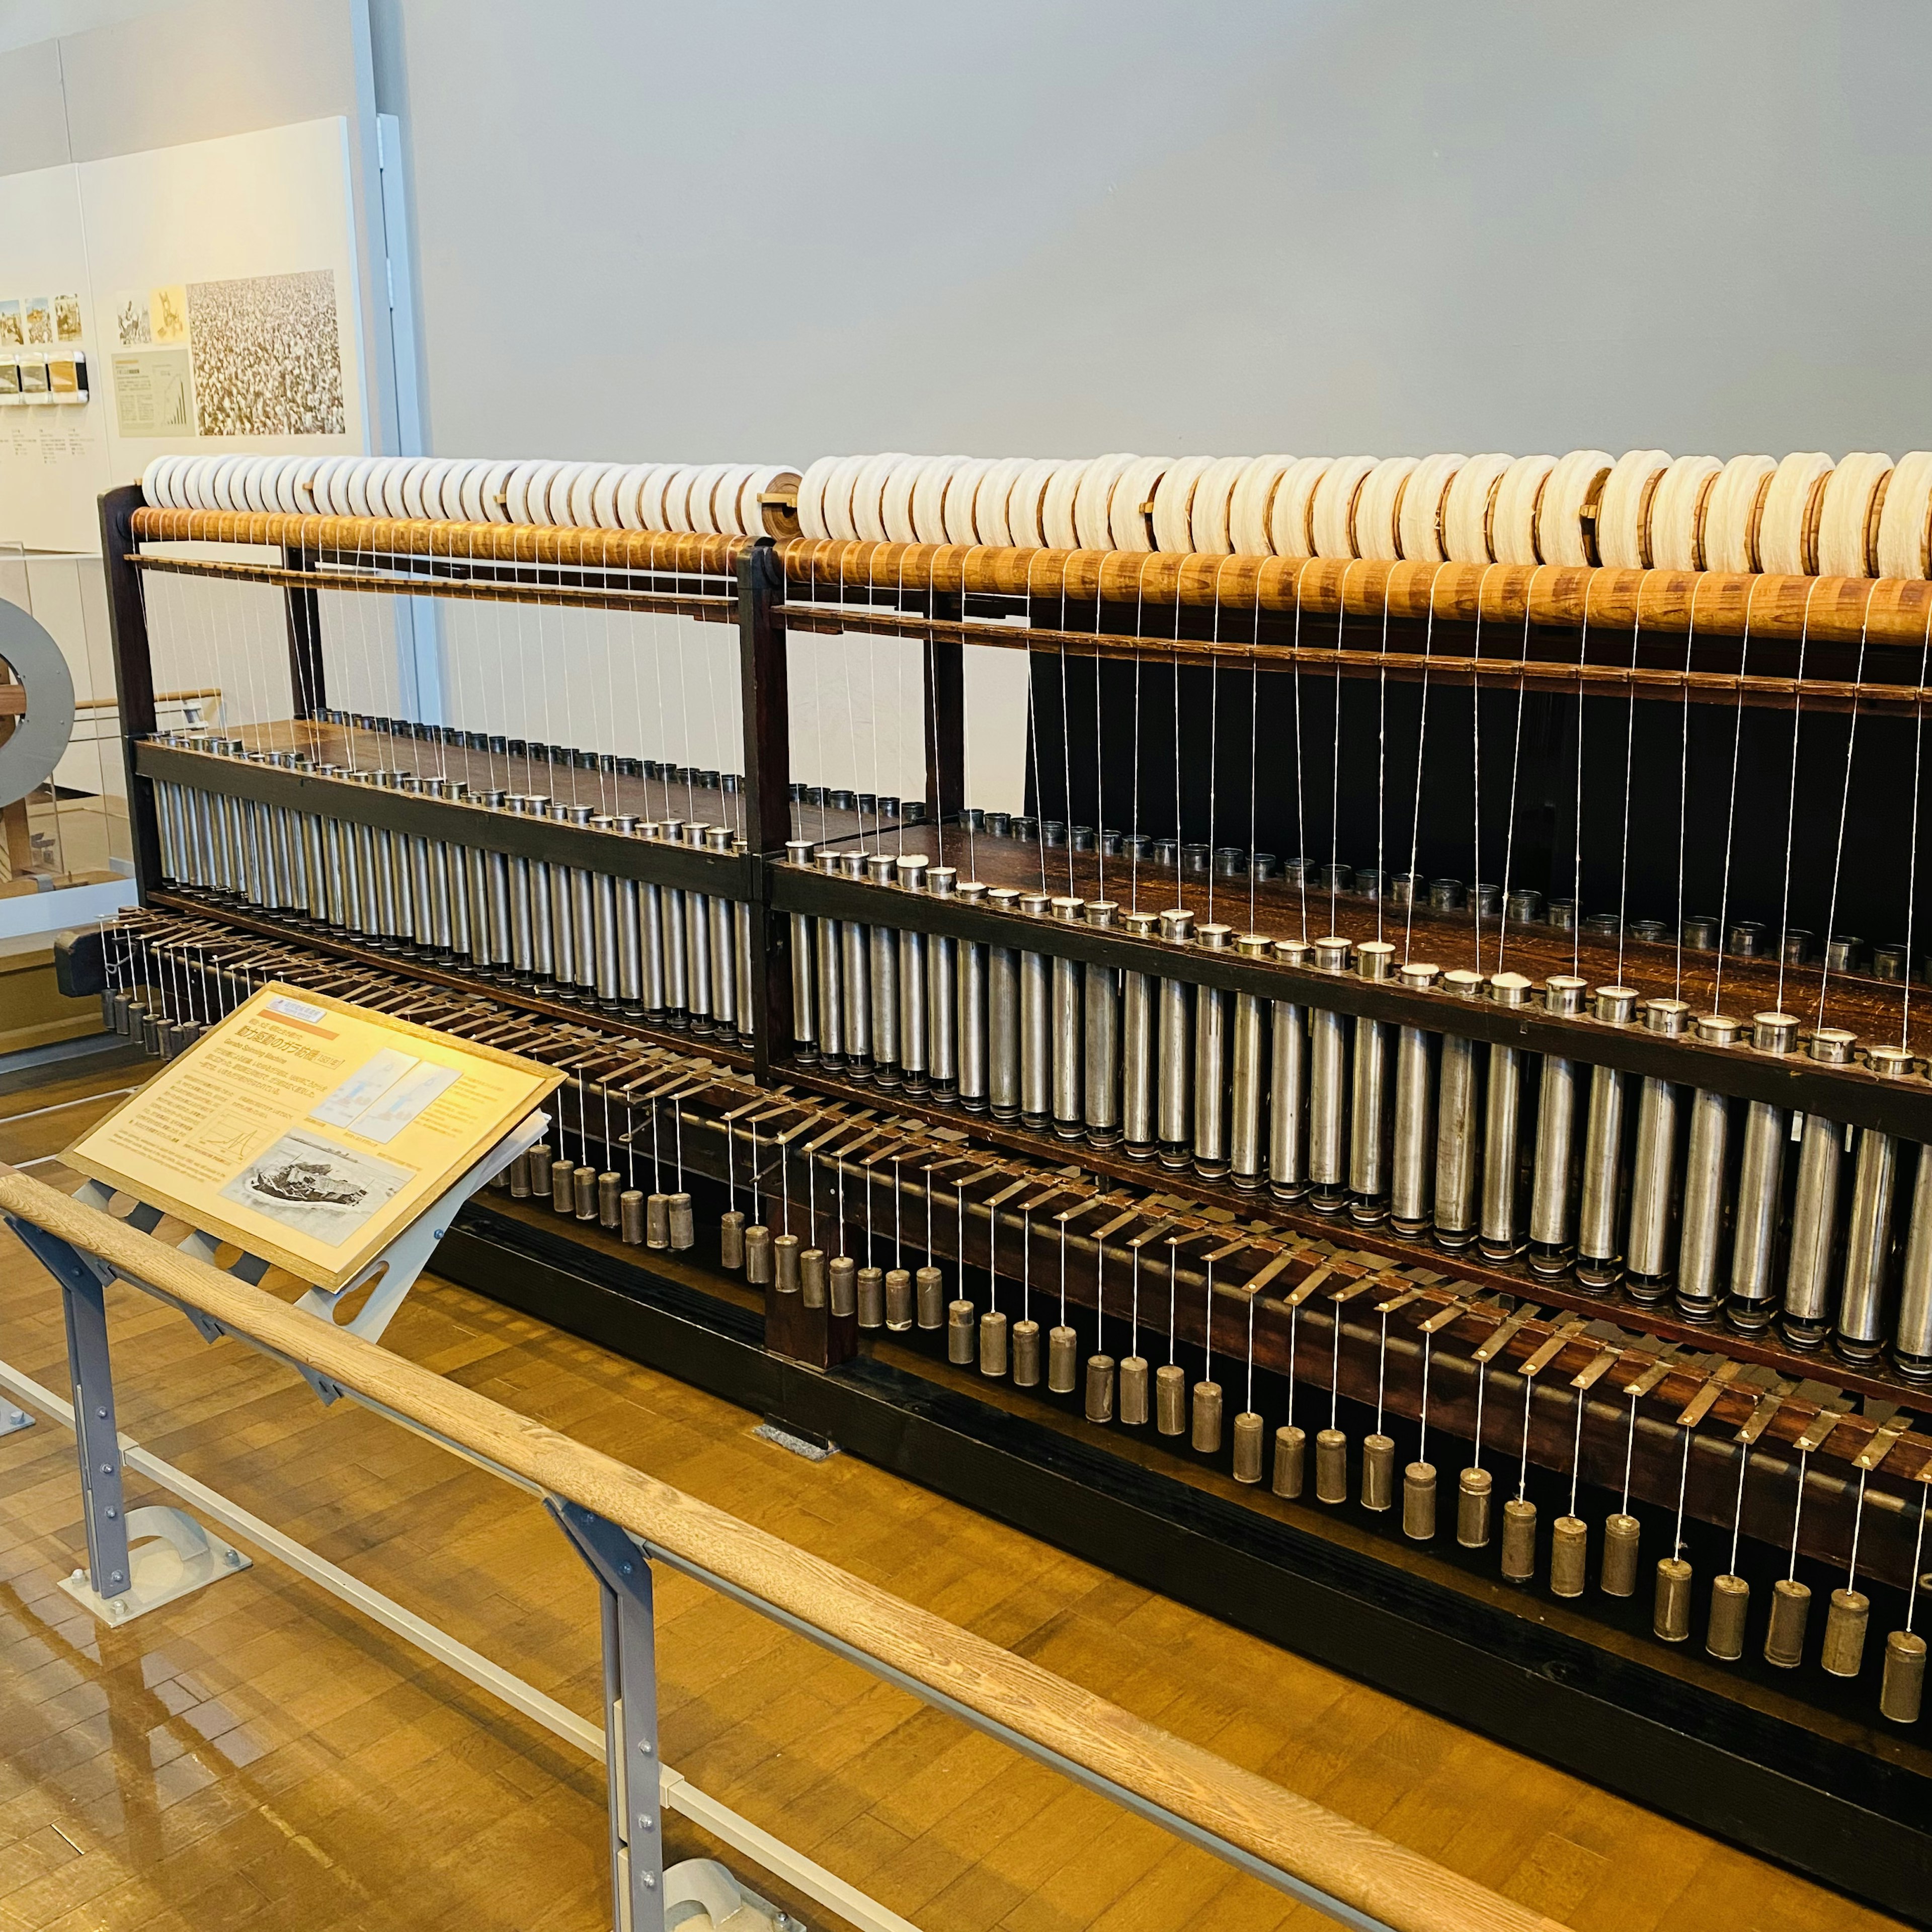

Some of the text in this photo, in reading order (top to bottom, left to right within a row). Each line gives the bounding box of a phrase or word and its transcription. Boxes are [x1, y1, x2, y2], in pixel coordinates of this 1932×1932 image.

[224, 1038, 287, 1064] Garabo Spinning Machine
